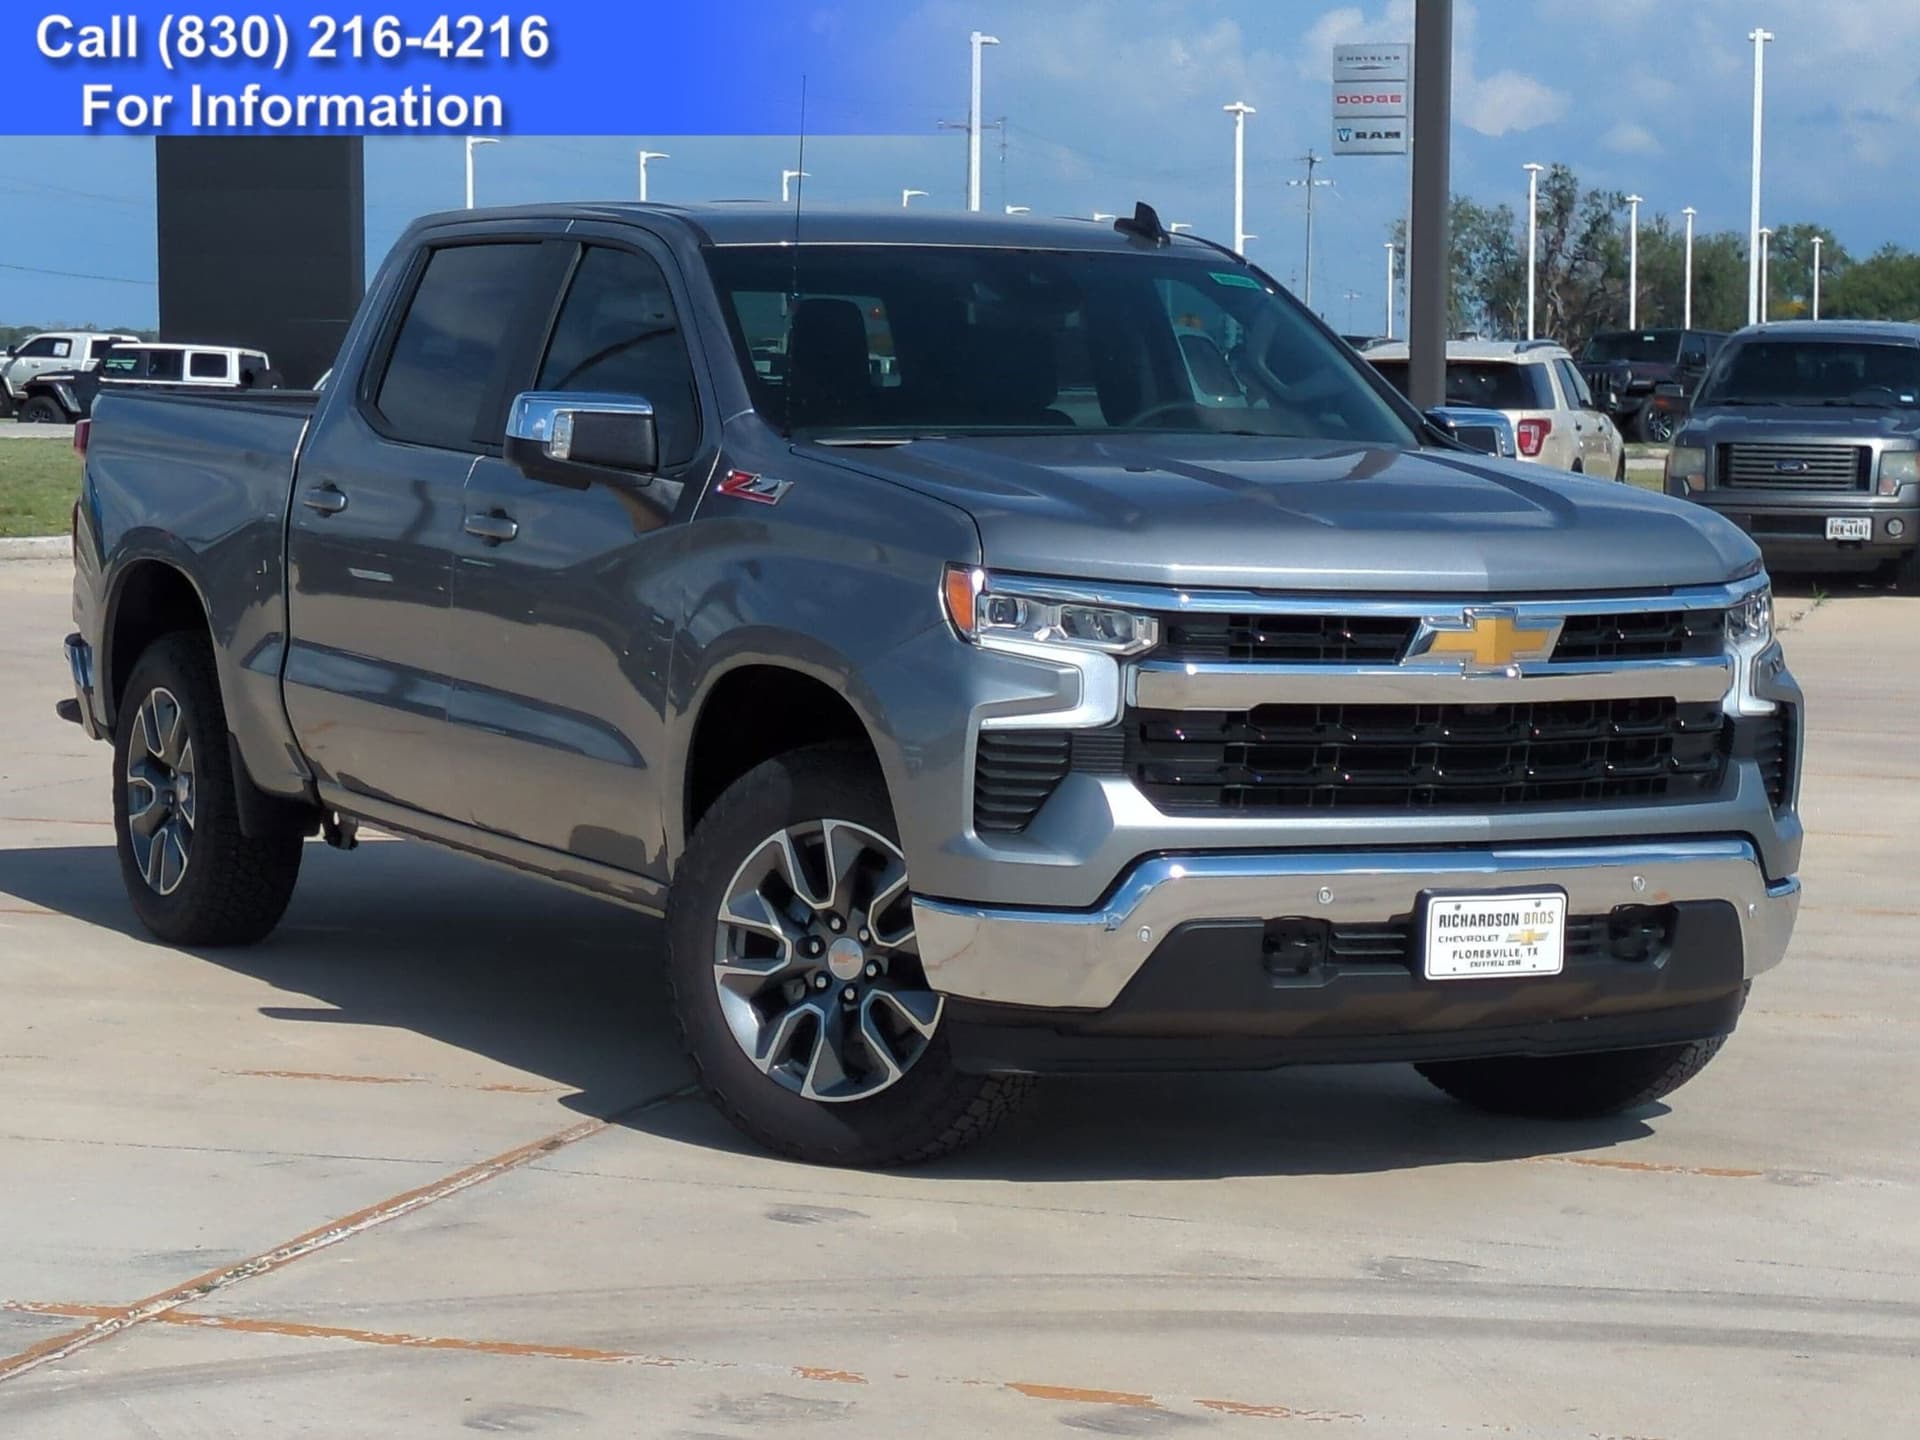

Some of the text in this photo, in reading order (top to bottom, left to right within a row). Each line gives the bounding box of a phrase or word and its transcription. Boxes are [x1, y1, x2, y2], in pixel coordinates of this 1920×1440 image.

[1336, 95, 1402, 104] DODGE
[1355, 131, 1401, 139] RAM
[1438, 912, 1520, 928] RICHARDSON
[1438, 934, 1500, 944] CHEVROLET
[1452, 947, 1538, 960] FLORESVILLE, TX
